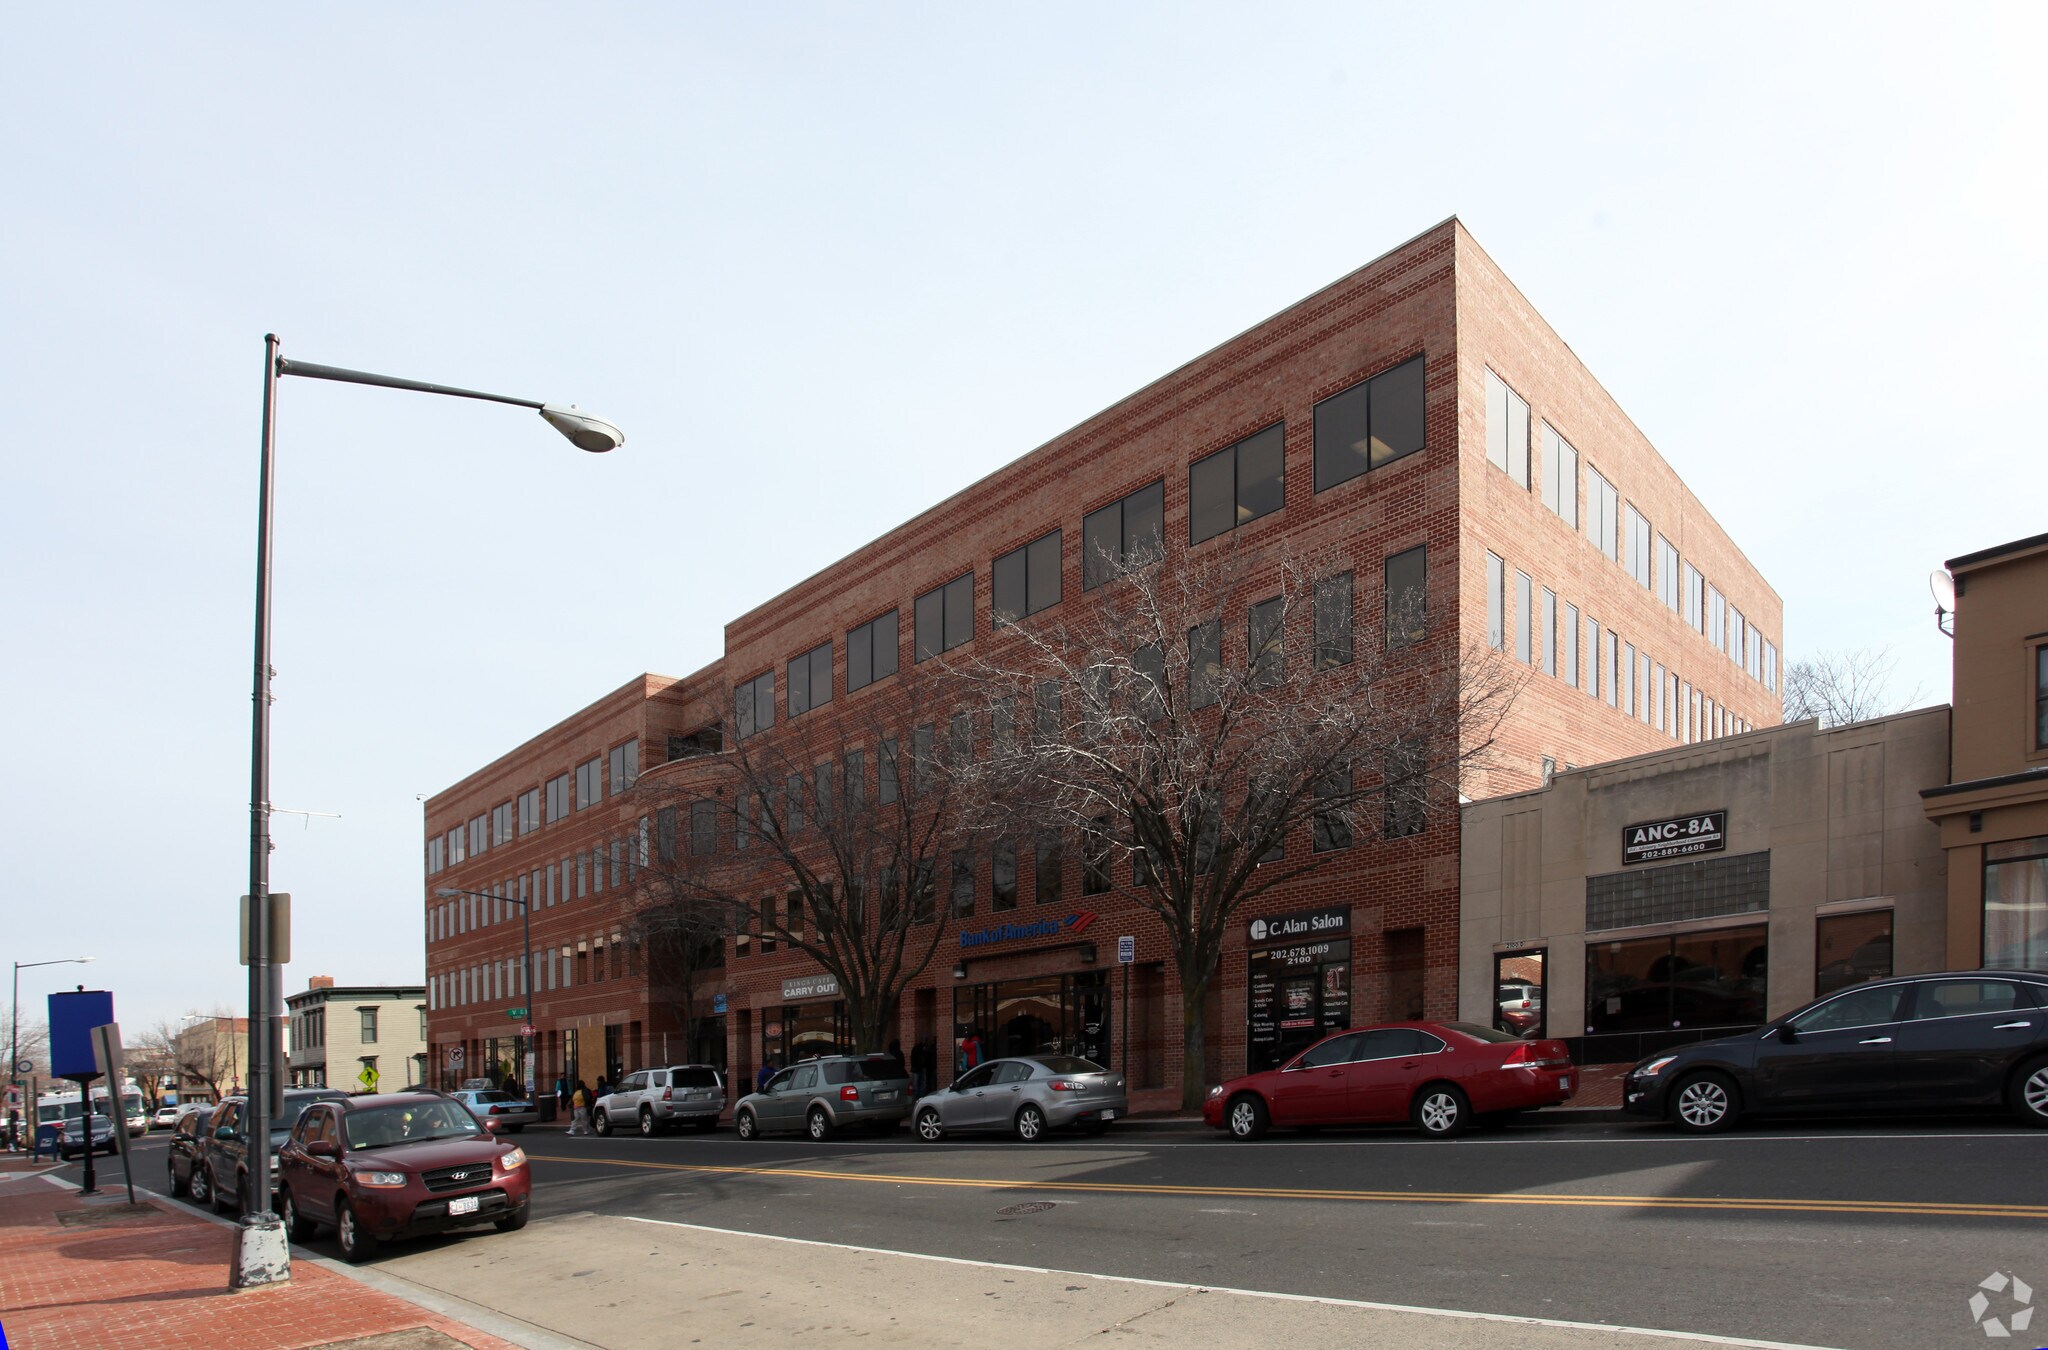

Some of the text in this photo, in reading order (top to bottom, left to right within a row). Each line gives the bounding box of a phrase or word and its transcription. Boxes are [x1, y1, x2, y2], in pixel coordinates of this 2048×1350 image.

[1633, 817, 1715, 843] ANC-8A
[1641, 843, 1705, 859] 202-889-6600
[1269, 914, 1343, 936] C. Alan Salon
[960, 920, 1059, 947] Bank of America
[1270, 944, 1329, 960] 202.678.1009
[1287, 956, 1311, 965] 2100
[784, 983, 836, 998] CARRY OUT
